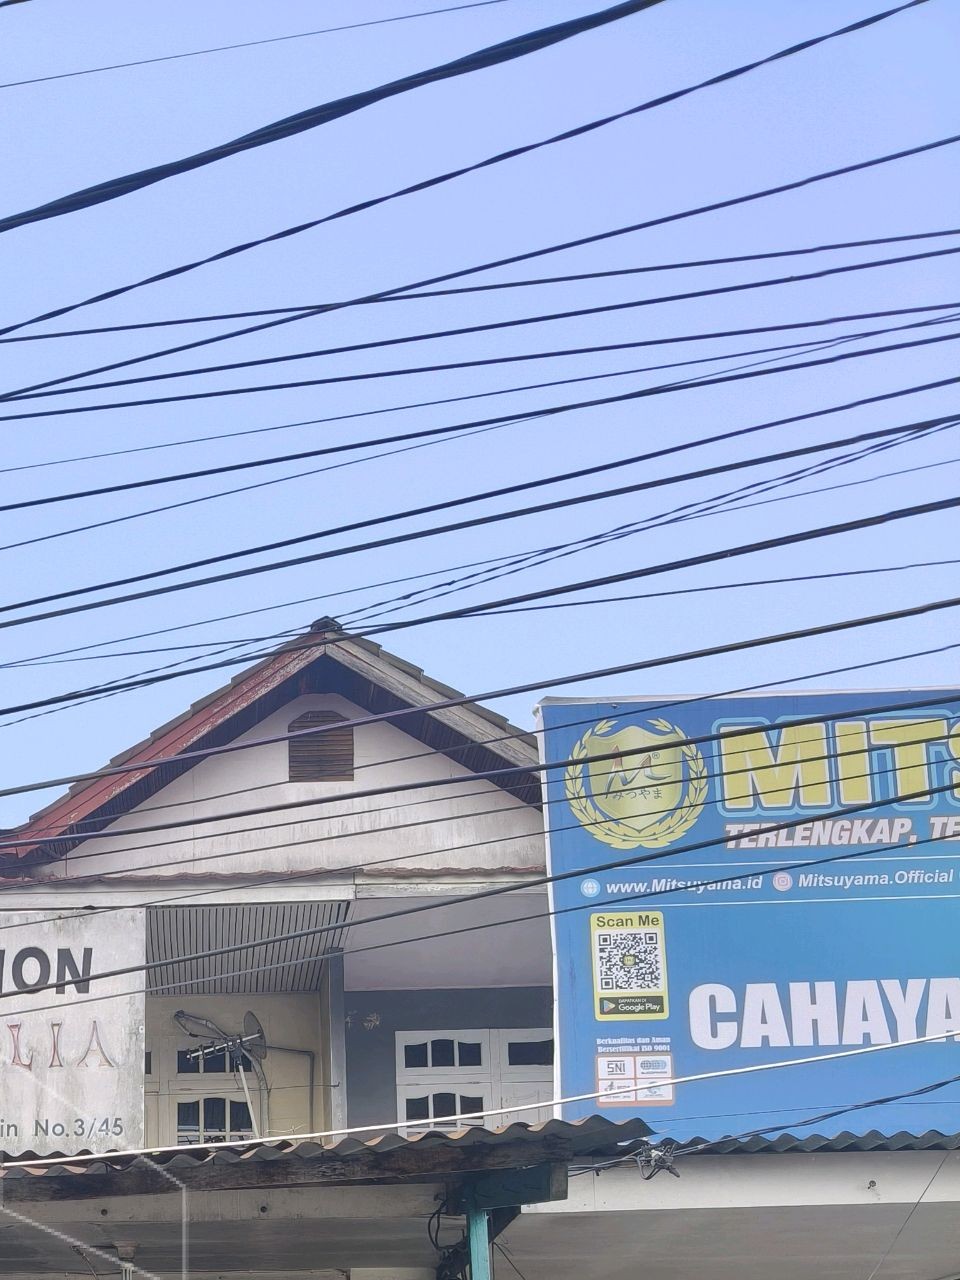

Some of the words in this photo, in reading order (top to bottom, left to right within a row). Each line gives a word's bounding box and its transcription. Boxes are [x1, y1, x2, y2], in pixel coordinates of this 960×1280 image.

[720, 718, 960, 809] MIT
[606, 875, 763, 894] www.Mitsuyama.id
[798, 869, 954, 889] Mitsuyama.Official
[596, 916, 634, 928] Scan
[638, 915, 660, 926] Me
[618, 1003, 645, 1012] Google
[645, 1003, 660, 1012] Play
[688, 977, 960, 1050] CAHAYA
[607, 1061, 626, 1074] SNI
